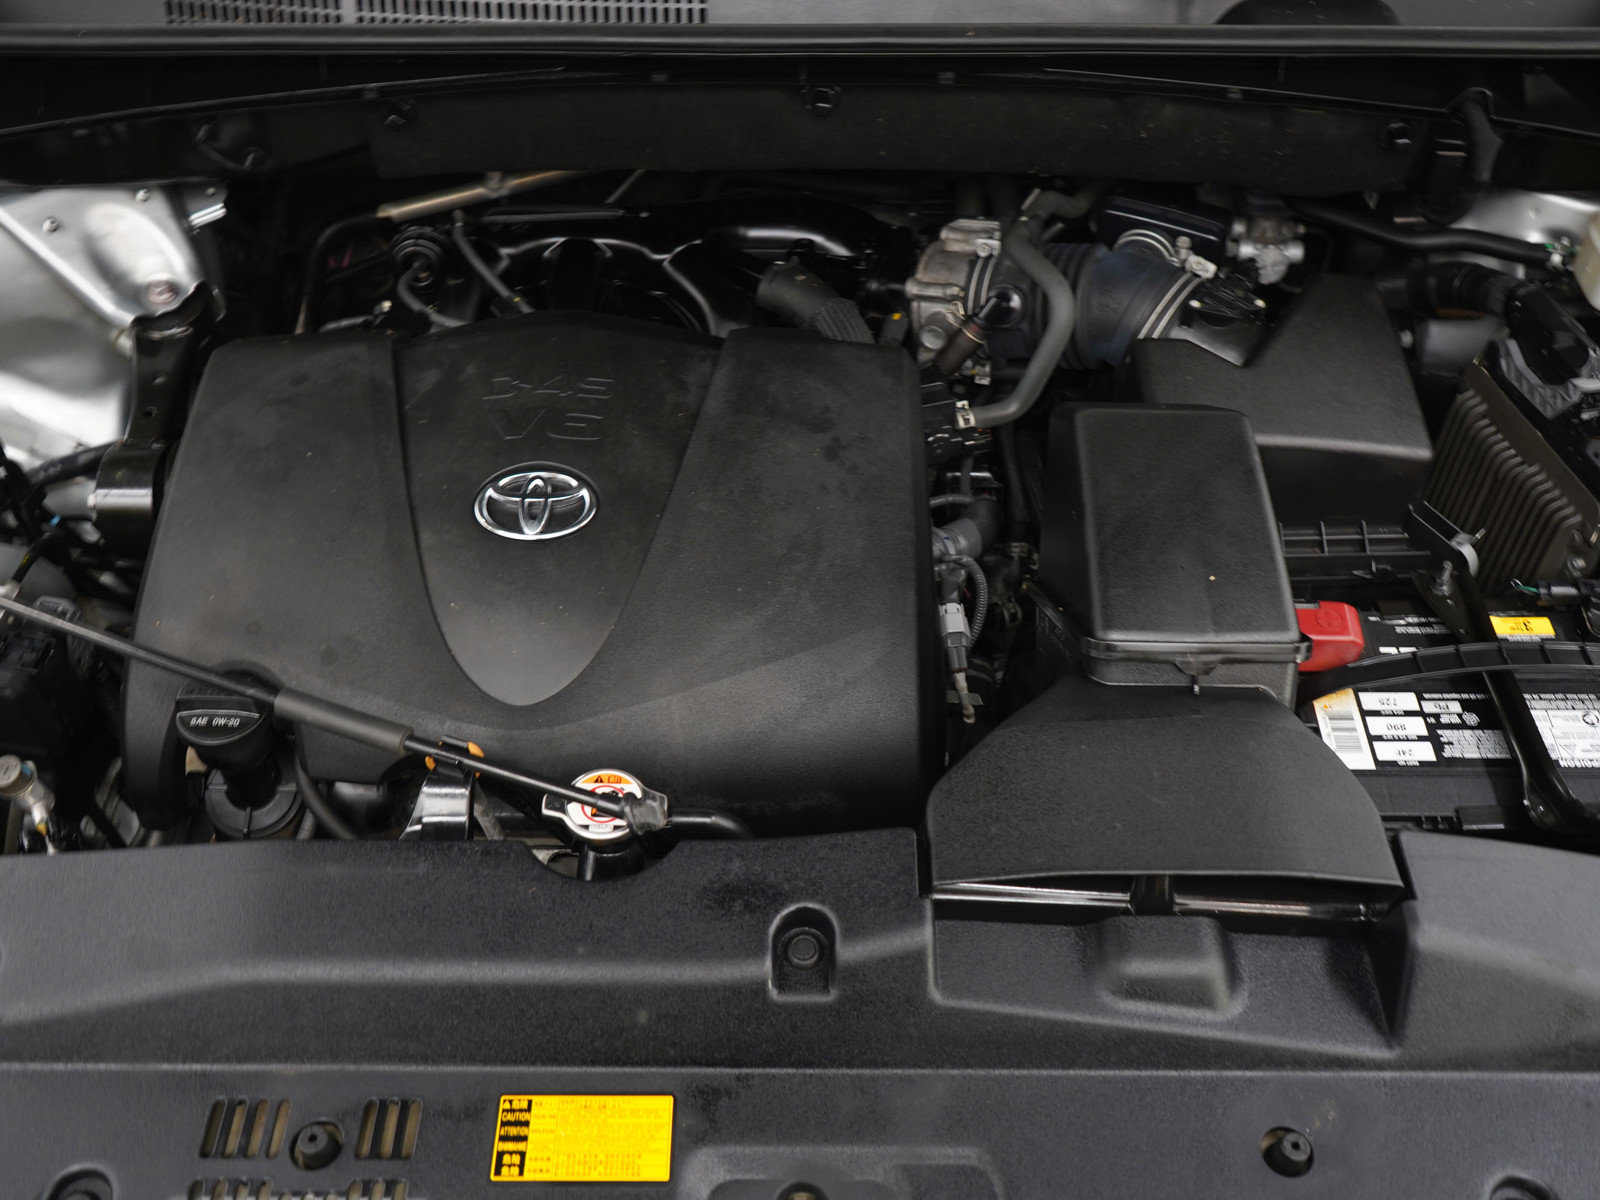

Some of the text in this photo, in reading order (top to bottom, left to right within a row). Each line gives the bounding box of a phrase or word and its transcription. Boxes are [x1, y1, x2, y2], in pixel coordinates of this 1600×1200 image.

[489, 409, 603, 440] V6
[190, 716, 240, 728] SAE 0W-20
[502, 1111, 531, 1121] CAUTION
[500, 1126, 529, 1136] ATTENTION
